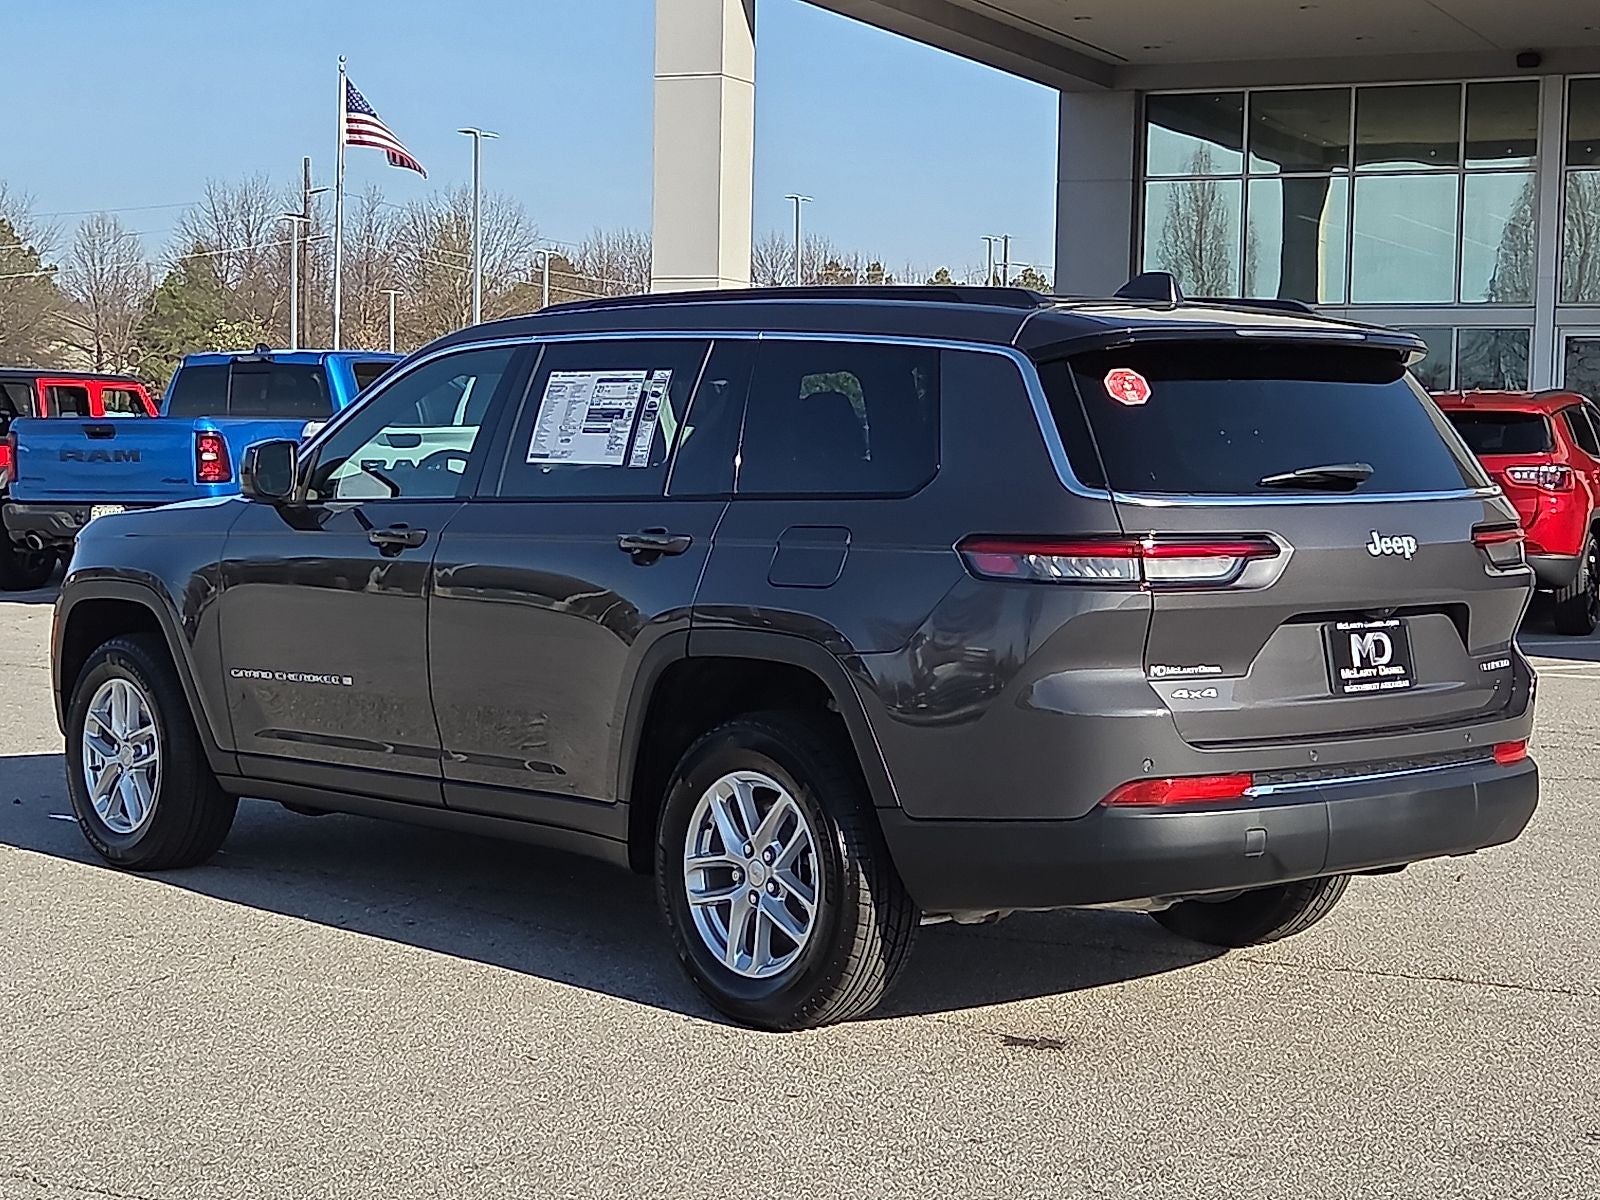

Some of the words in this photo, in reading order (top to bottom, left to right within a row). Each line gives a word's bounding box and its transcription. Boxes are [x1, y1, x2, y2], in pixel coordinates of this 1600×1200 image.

[59, 449, 141, 463] RAM
[1367, 530, 1418, 560] Jeep
[1350, 631, 1393, 667] MD
